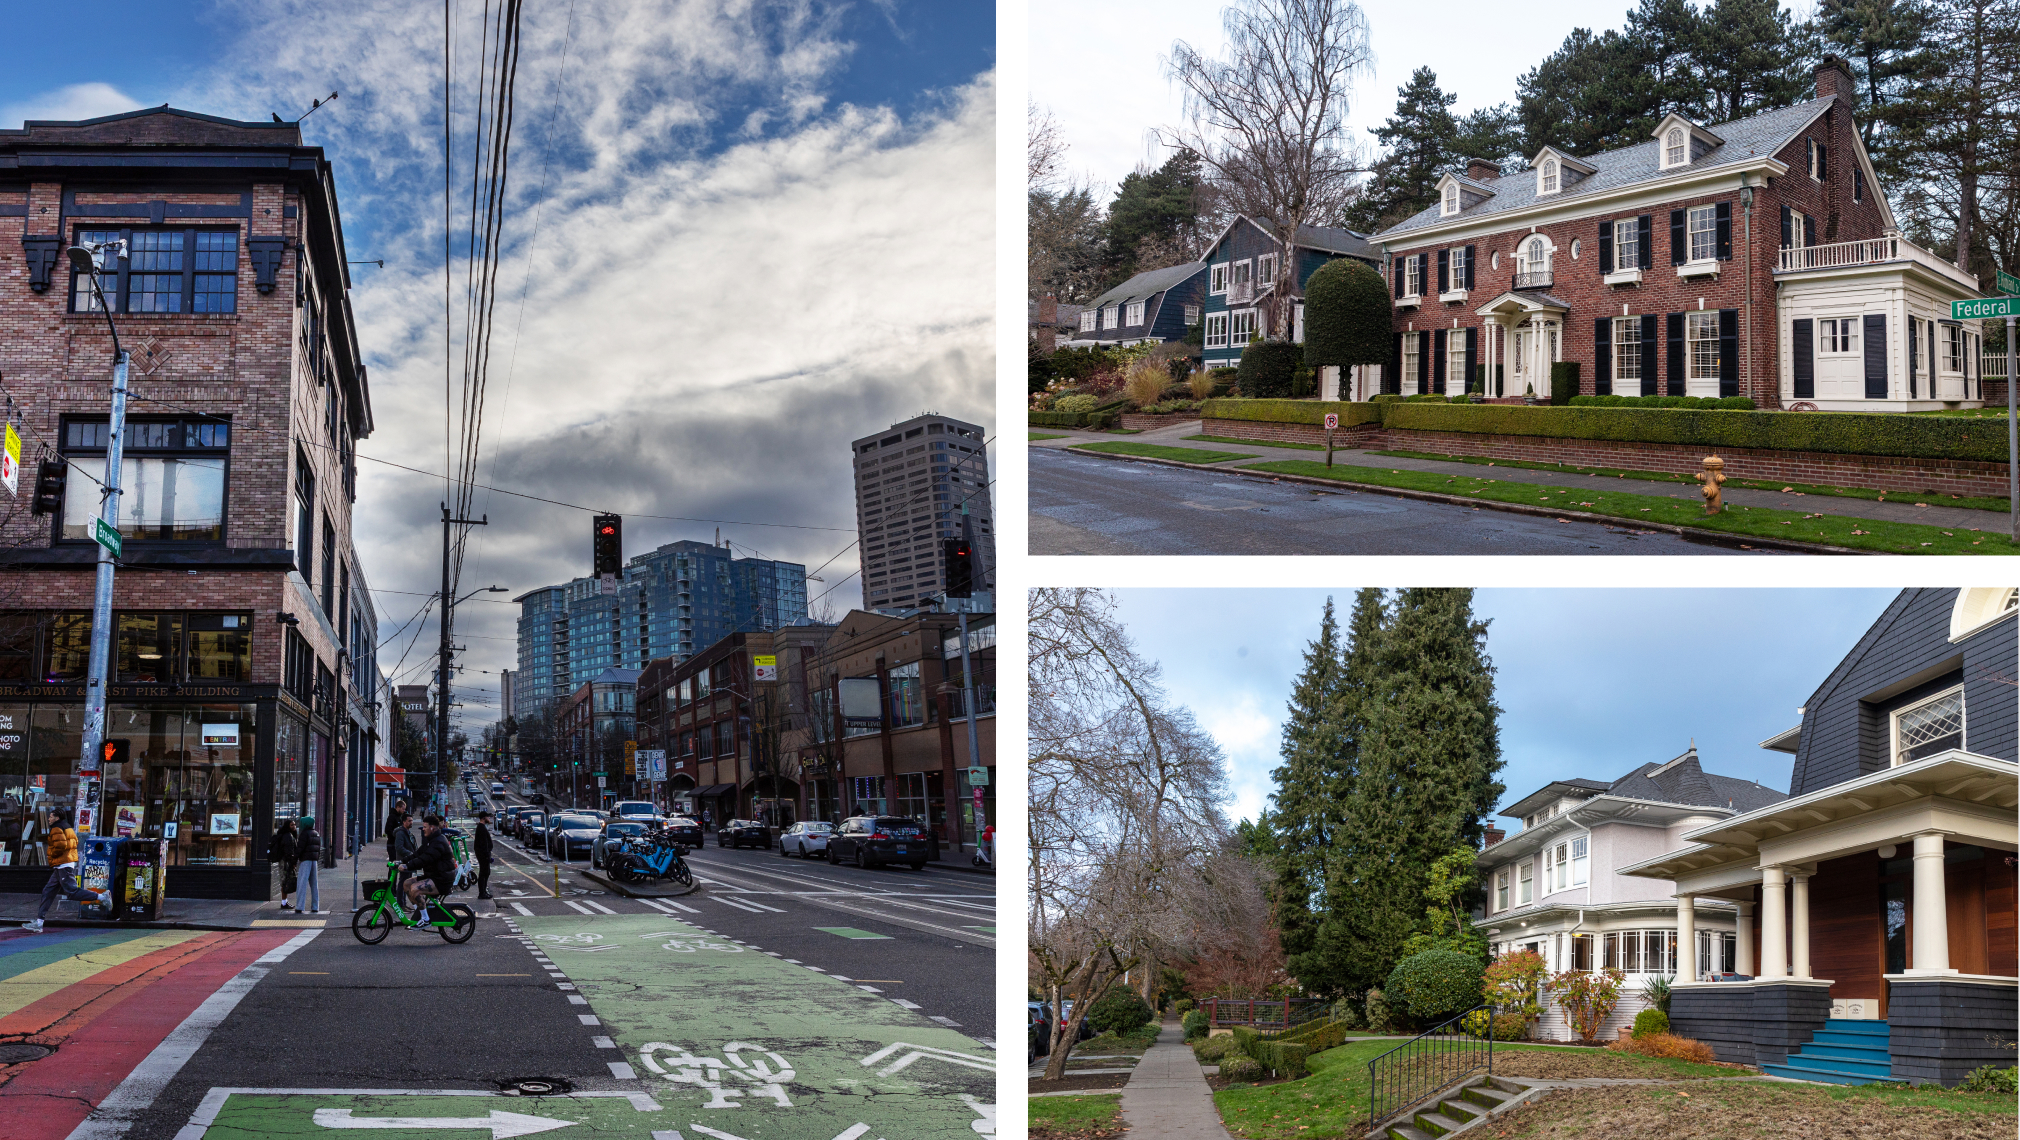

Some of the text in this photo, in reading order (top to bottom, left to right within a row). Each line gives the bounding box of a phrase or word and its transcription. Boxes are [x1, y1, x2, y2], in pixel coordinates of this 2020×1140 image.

[1957, 300, 2010, 317] Federal
[99, 524, 120, 555] Broadway
[77, 687, 86, 696] &
[106, 687, 128, 696] AST
[136, 687, 168, 697] PIKE
[176, 687, 240, 696] BUILDING
